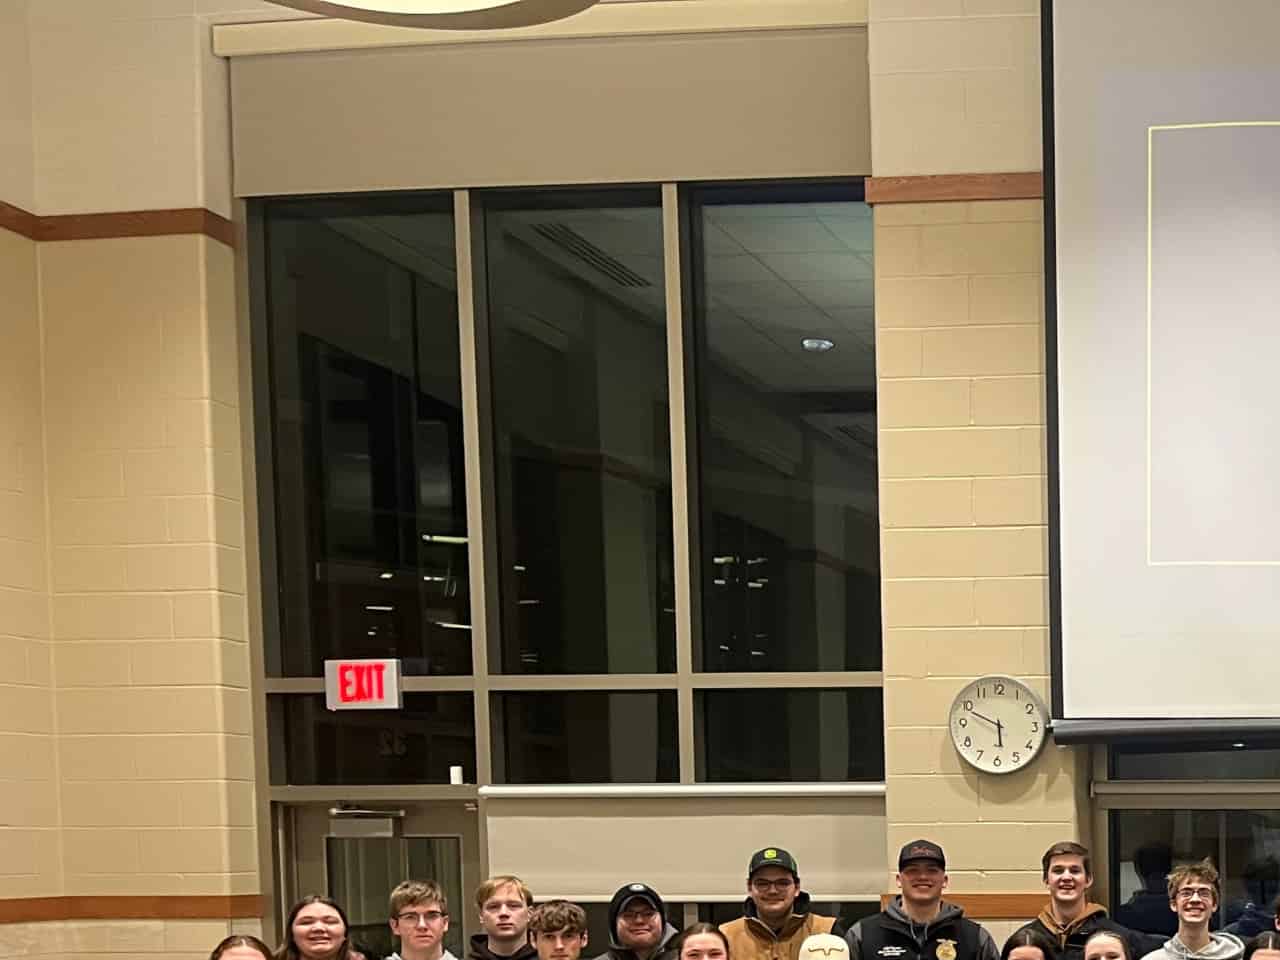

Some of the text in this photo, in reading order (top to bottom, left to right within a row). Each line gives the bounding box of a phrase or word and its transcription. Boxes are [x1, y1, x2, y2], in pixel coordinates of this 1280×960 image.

[338, 663, 385, 703] EXIT
[976, 687, 986, 699] 11
[993, 684, 1005, 696] 12
[963, 700, 974, 712] 10
[1025, 703, 1035, 714] 2
[960, 718, 968, 728] 9
[1031, 721, 1039, 733] 3
[964, 736, 972, 747] 8
[1025, 739, 1033, 750] 4
[976, 750, 985, 761] 7
[1012, 752, 1020, 763] 5
[993, 756, 1002, 767] 6
